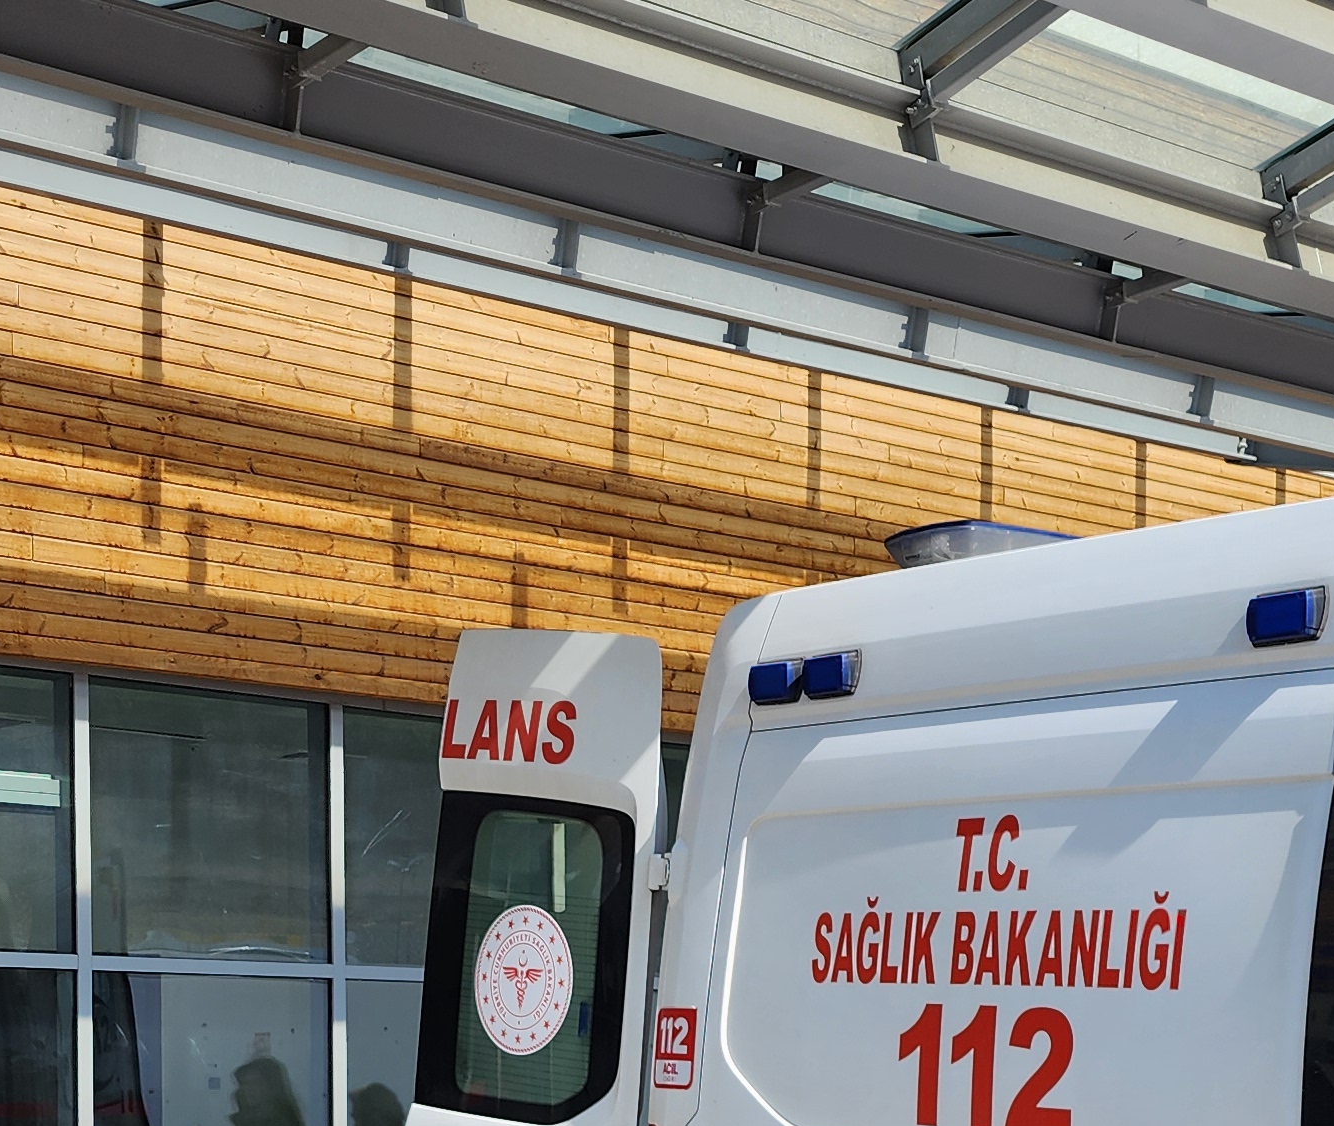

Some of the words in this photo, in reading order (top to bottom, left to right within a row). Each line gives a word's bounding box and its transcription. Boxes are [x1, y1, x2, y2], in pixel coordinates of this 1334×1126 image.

[441, 699, 577, 765] LANS
[956, 814, 1030, 892] T.C.
[811, 895, 942, 985] SAĞLIK
[949, 891, 1188, 991] BAKANLIĞI
[660, 1016, 689, 1055] 112
